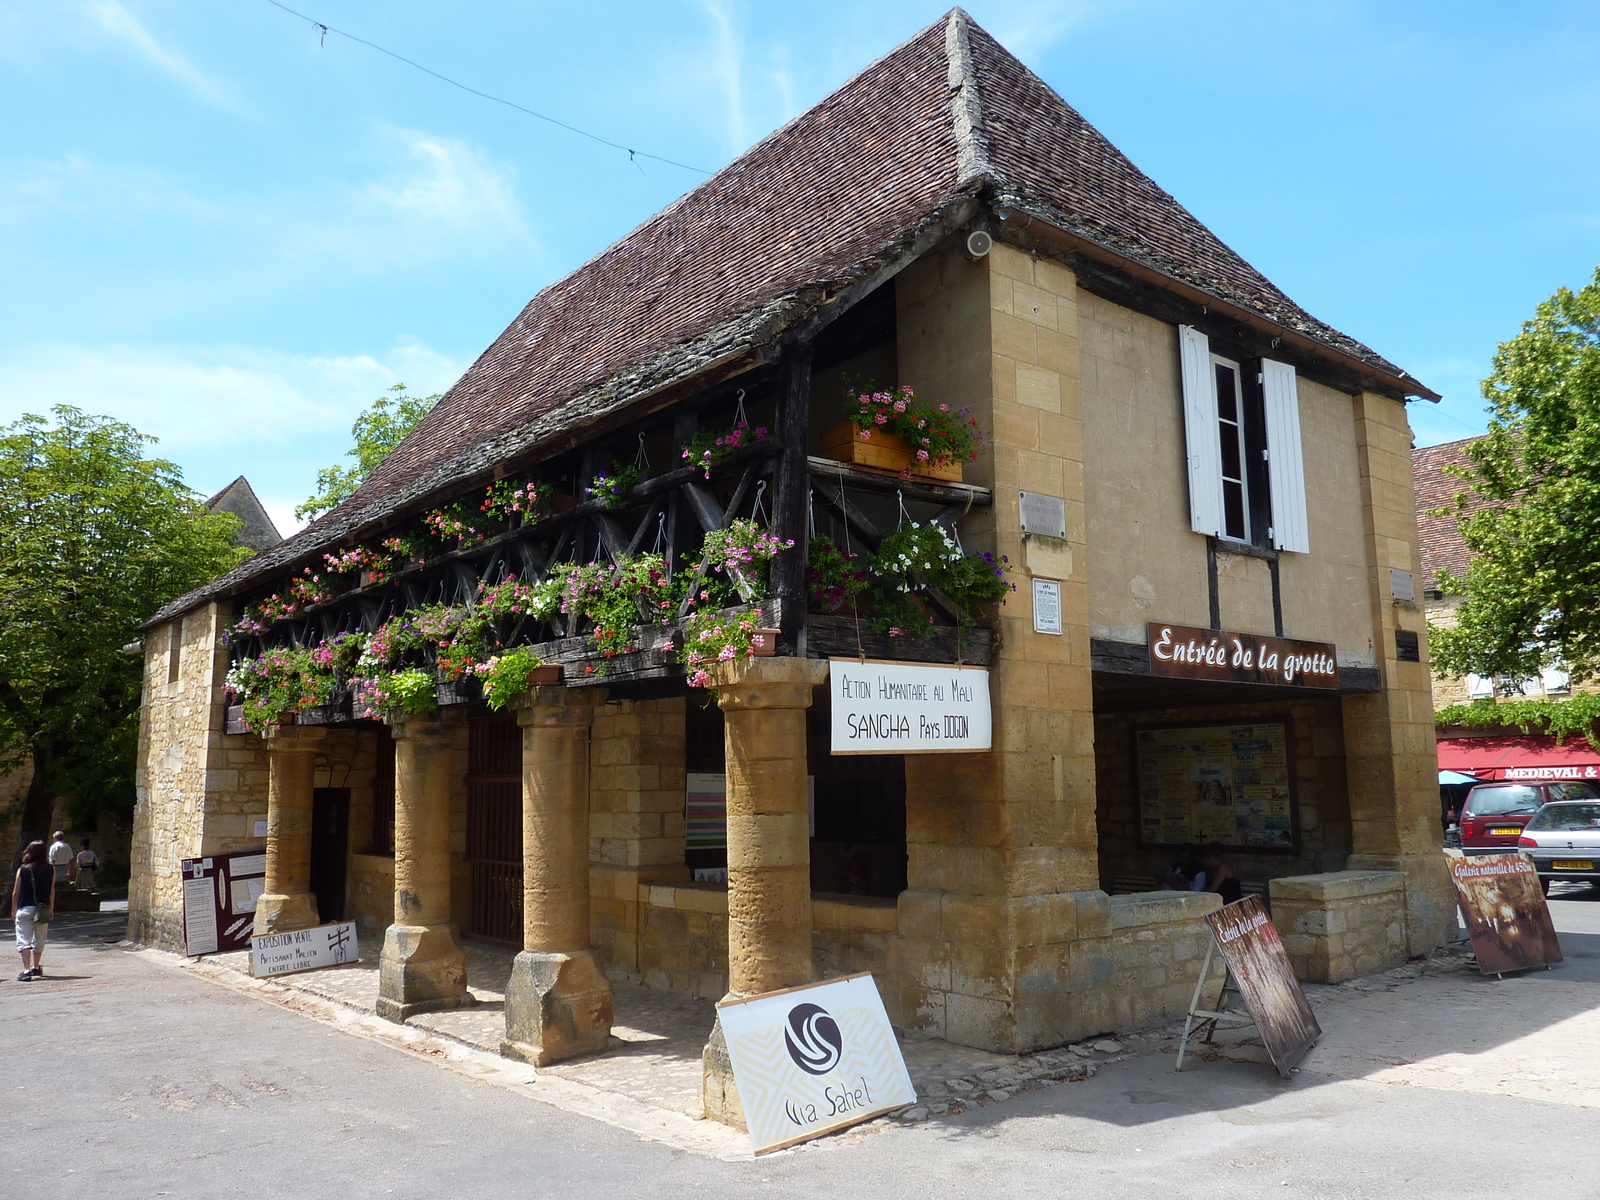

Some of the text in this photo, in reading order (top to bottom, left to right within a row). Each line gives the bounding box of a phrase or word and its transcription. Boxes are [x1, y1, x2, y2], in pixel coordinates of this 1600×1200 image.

[1154, 627, 1335, 681] Entrée de la grotte
[842, 674, 973, 702] ACTION HUMANITAIRE AU MALI
[847, 713, 969, 739] SANGHA PAYS DOGON
[1504, 766, 1597, 779] MEDIEVAL &
[1454, 864, 1480, 880] Galerie
[1506, 860, 1515, 874] de
[258, 930, 313, 950] EXPOSITION VENTE
[260, 947, 317, 965] ARTISANAT MALIEN
[293, 960, 311, 970] LIBRE
[785, 1076, 873, 1126] Via Sahel
